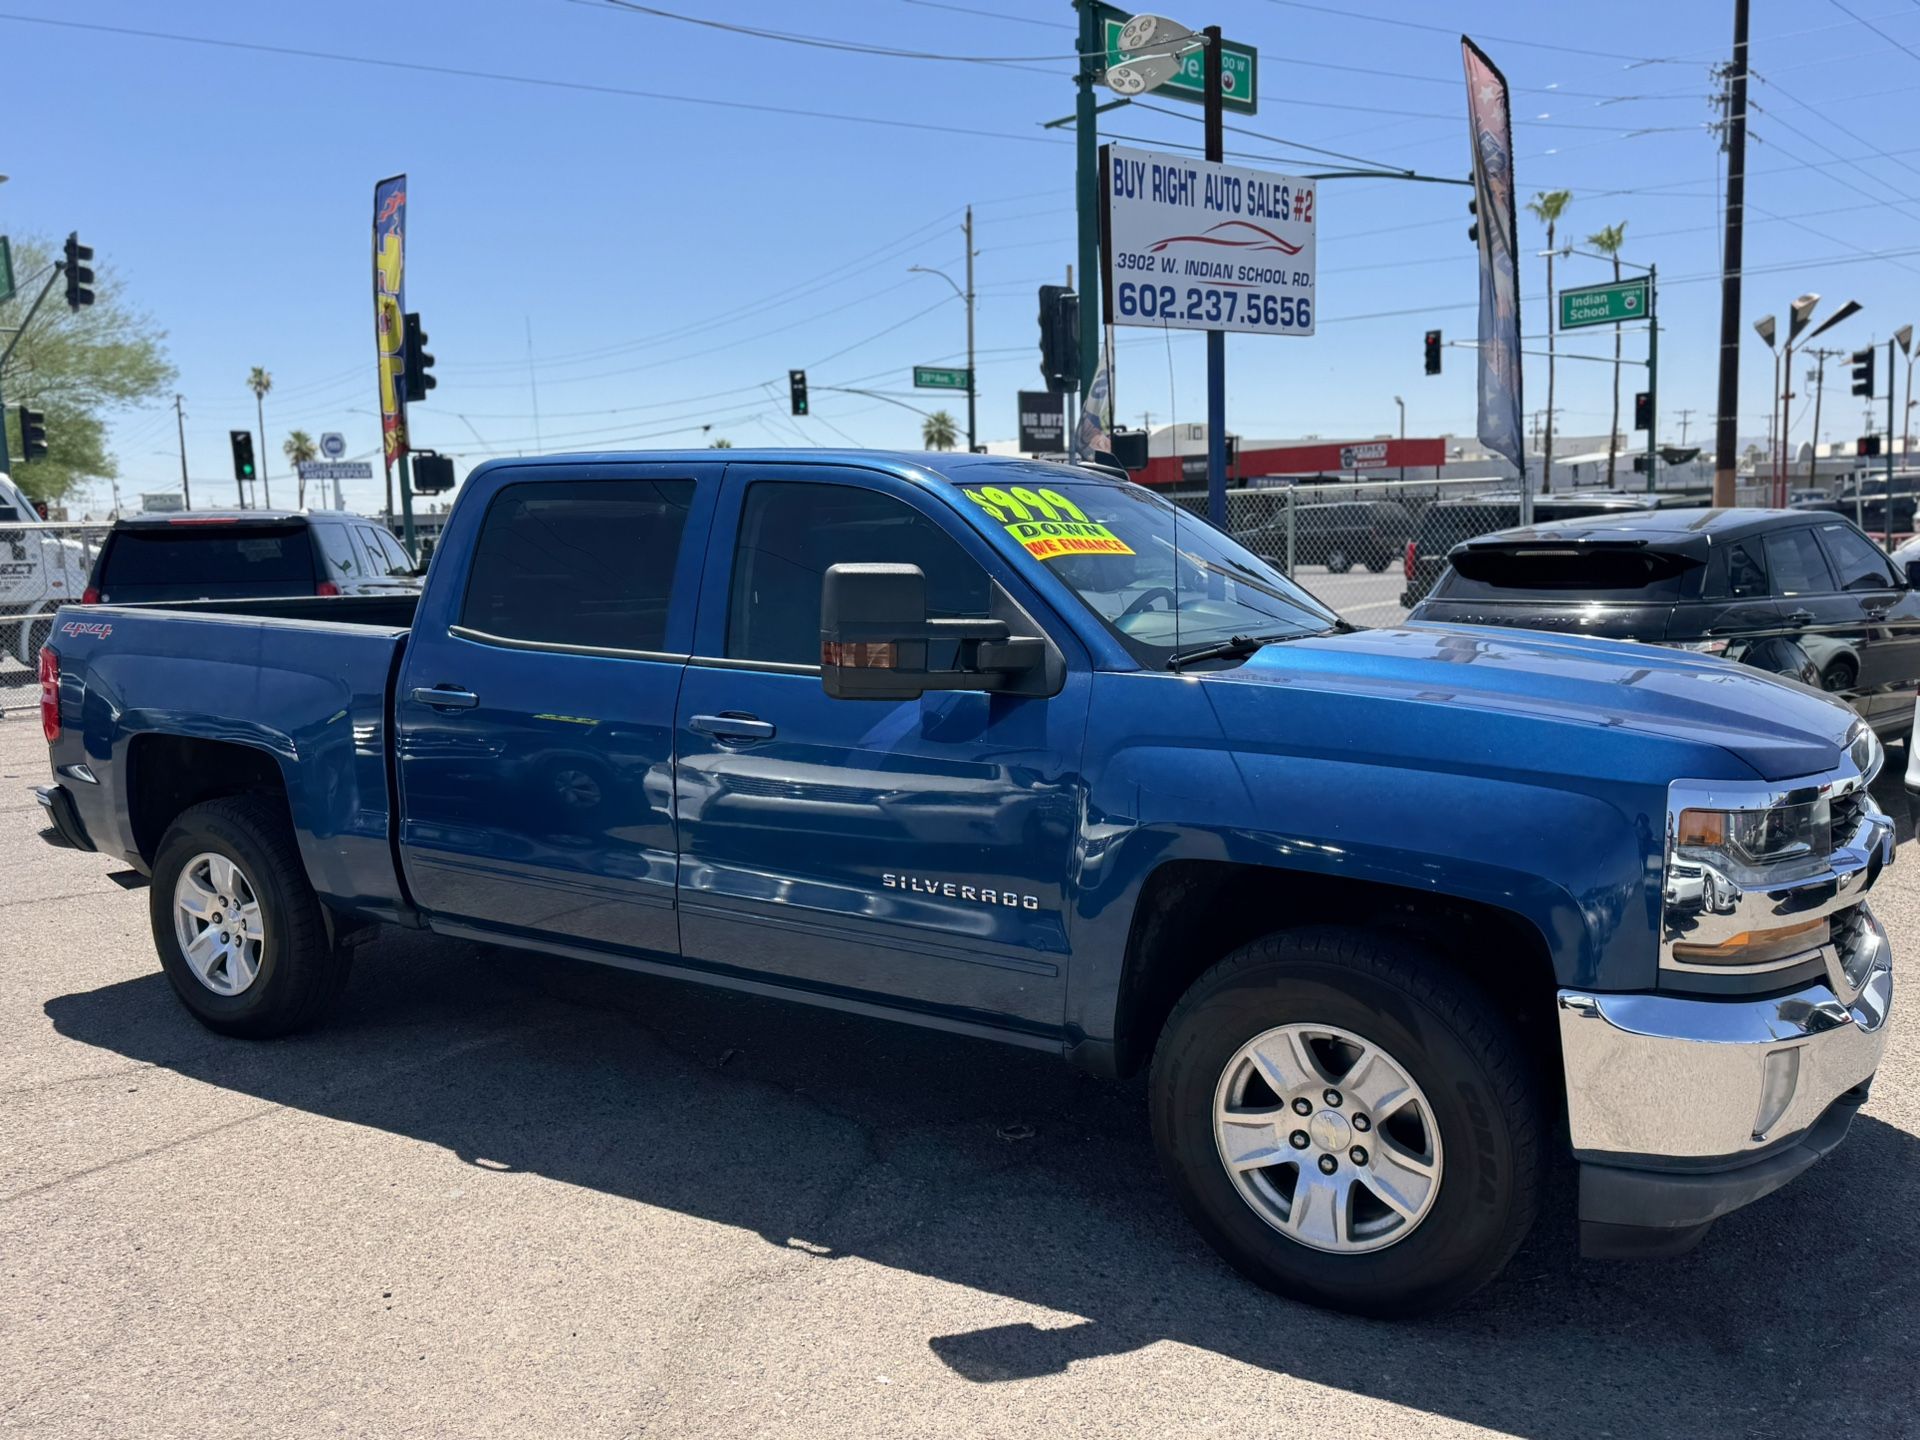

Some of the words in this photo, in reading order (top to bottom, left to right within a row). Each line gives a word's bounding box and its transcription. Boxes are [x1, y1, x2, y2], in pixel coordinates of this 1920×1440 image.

[1237, 61, 1245, 72] W
[1113, 158, 1146, 200] BUY
[1152, 164, 1197, 208] RIGHT
[1204, 173, 1242, 214] AUTO
[1247, 180, 1290, 221] SALES
[1293, 188, 1313, 223] #2
[1117, 252, 1155, 272] 3902
[1161, 257, 1179, 274] W.
[1184, 260, 1233, 280] INDIAN
[1238, 266, 1287, 285] SCHOOL
[1292, 271, 1312, 288] RD.
[1118, 282, 1311, 328] 602.237.5656
[1570, 304, 1610, 320] School
[1572, 294, 1608, 308] Indian
[962, 486, 1090, 524] $999
[1017, 522, 1106, 538] DOWN
[1025, 539, 1057, 556] WE
[1057, 539, 1129, 552] FINANCE
[882, 873, 1039, 910] SILVERADO
